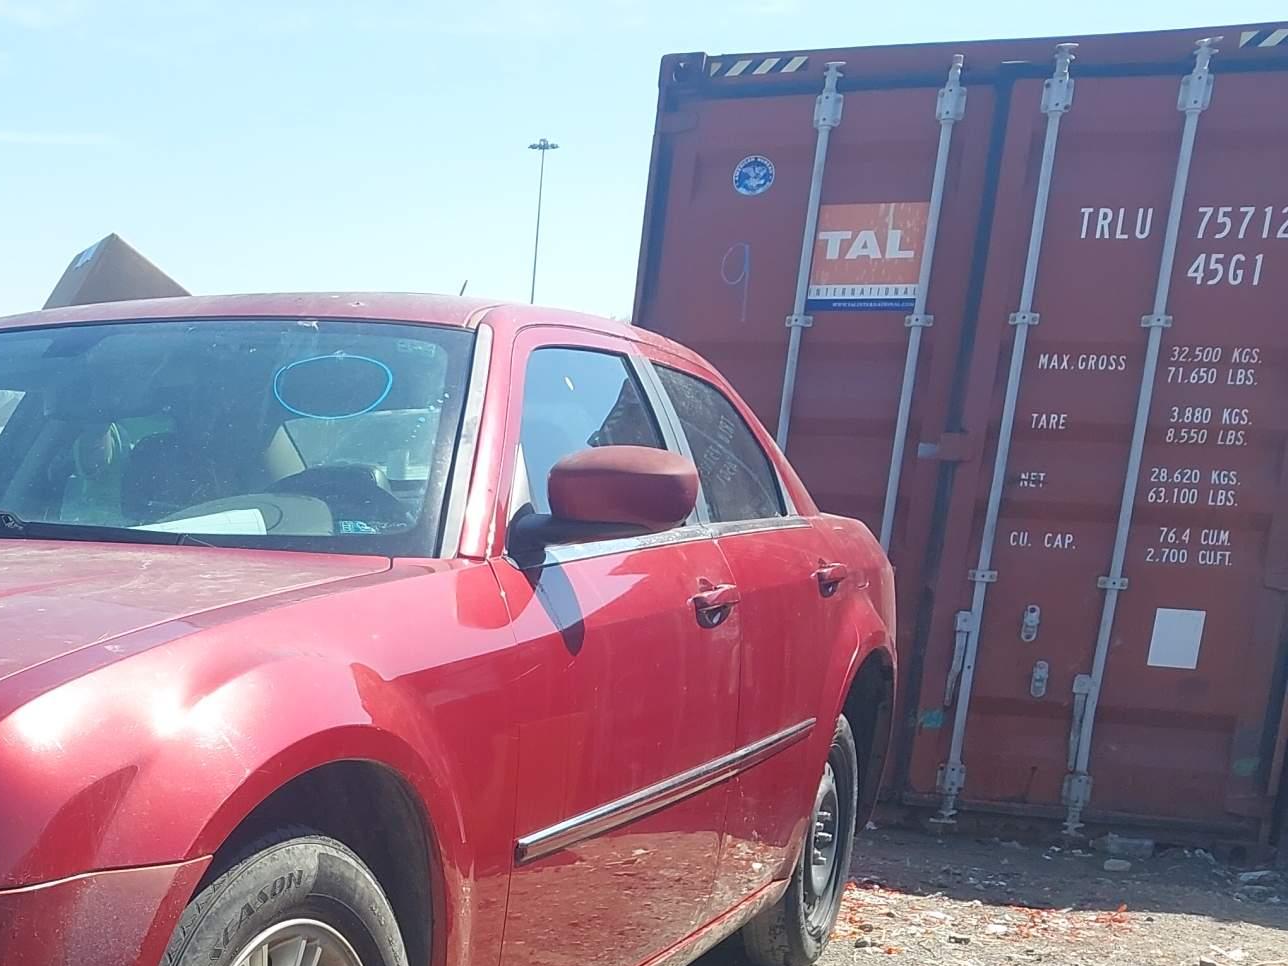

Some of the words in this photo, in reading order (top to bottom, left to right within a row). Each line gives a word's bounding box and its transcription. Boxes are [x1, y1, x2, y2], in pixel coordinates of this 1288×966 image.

[1080, 206, 1154, 240] TRLU
[818, 229, 915, 260] TAL
[1187, 252, 1264, 286] 45G1
[808, 286, 917, 297] INTERNATIONAL
[1039, 353, 1128, 371] MAX.GROSS
[1170, 346, 1223, 363] 32.500
[1231, 347, 1263, 364] KGS.
[1167, 367, 1218, 384] 71.650
[1227, 369, 1259, 386] LBS.
[1031, 413, 1069, 430] TARE
[1170, 406, 1212, 424] 3.880
[1222, 408, 1254, 426] KGS.
[1166, 428, 1209, 444] 8.550
[1217, 430, 1249, 447] LBS.
[1019, 472, 1047, 488] NET
[1150, 467, 1201, 484] 28.620
[1211, 470, 1242, 487] KGS.
[1147, 487, 1199, 505] 63.100
[1208, 489, 1239, 507] LBS.
[1009, 531, 1032, 547] CU.
[1044, 532, 1077, 550] CAP.
[1159, 527, 1191, 545] 76.4
[1145, 548, 1188, 564] 2.700
